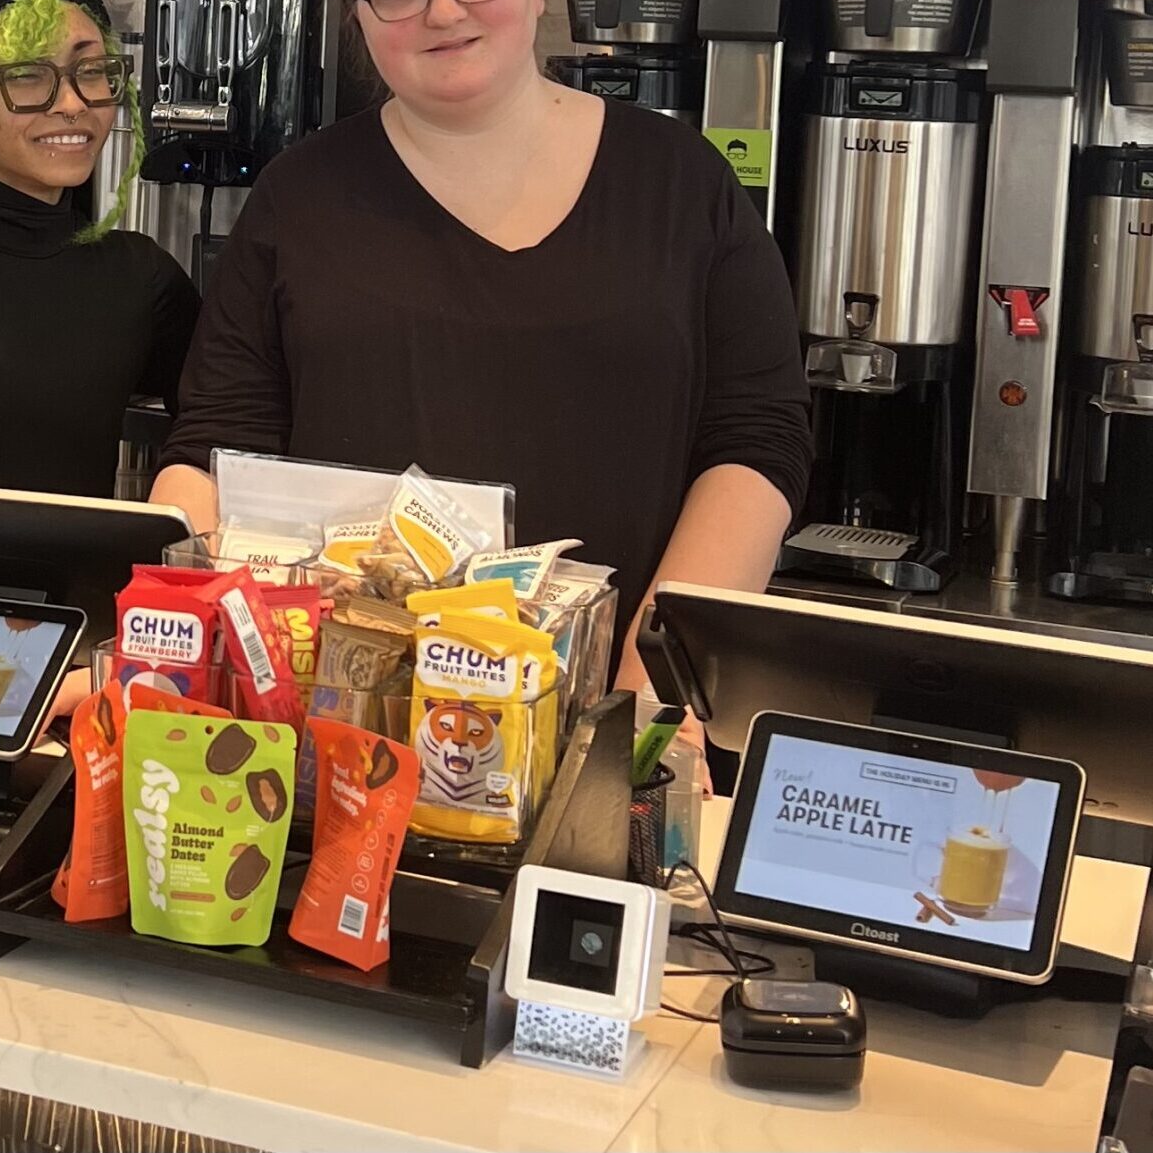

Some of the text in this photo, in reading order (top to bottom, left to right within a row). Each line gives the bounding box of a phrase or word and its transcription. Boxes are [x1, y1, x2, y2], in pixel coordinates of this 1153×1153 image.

[843, 137, 909, 154] LUXUS
[737, 166, 762, 175] HOUSE
[404, 505, 459, 551] CASHEWS
[247, 553, 279, 565] TRAIL
[130, 616, 194, 639] CHUM
[129, 634, 193, 650] FRUIT BITES
[128, 644, 192, 659] STRAWBERRY
[427, 643, 506, 671] CHUM
[424, 660, 506, 682] FRUIT BITES
[441, 675, 486, 688] MANGO
[774, 768, 814, 782] New!
[782, 784, 883, 818] CARAMEL
[173, 822, 224, 838] Almond
[776, 804, 844, 831] APPLE
[849, 817, 913, 844] LATTE
[171, 836, 215, 850] Butter
[170, 848, 206, 862] Dates
[865, 925, 899, 944] toast
